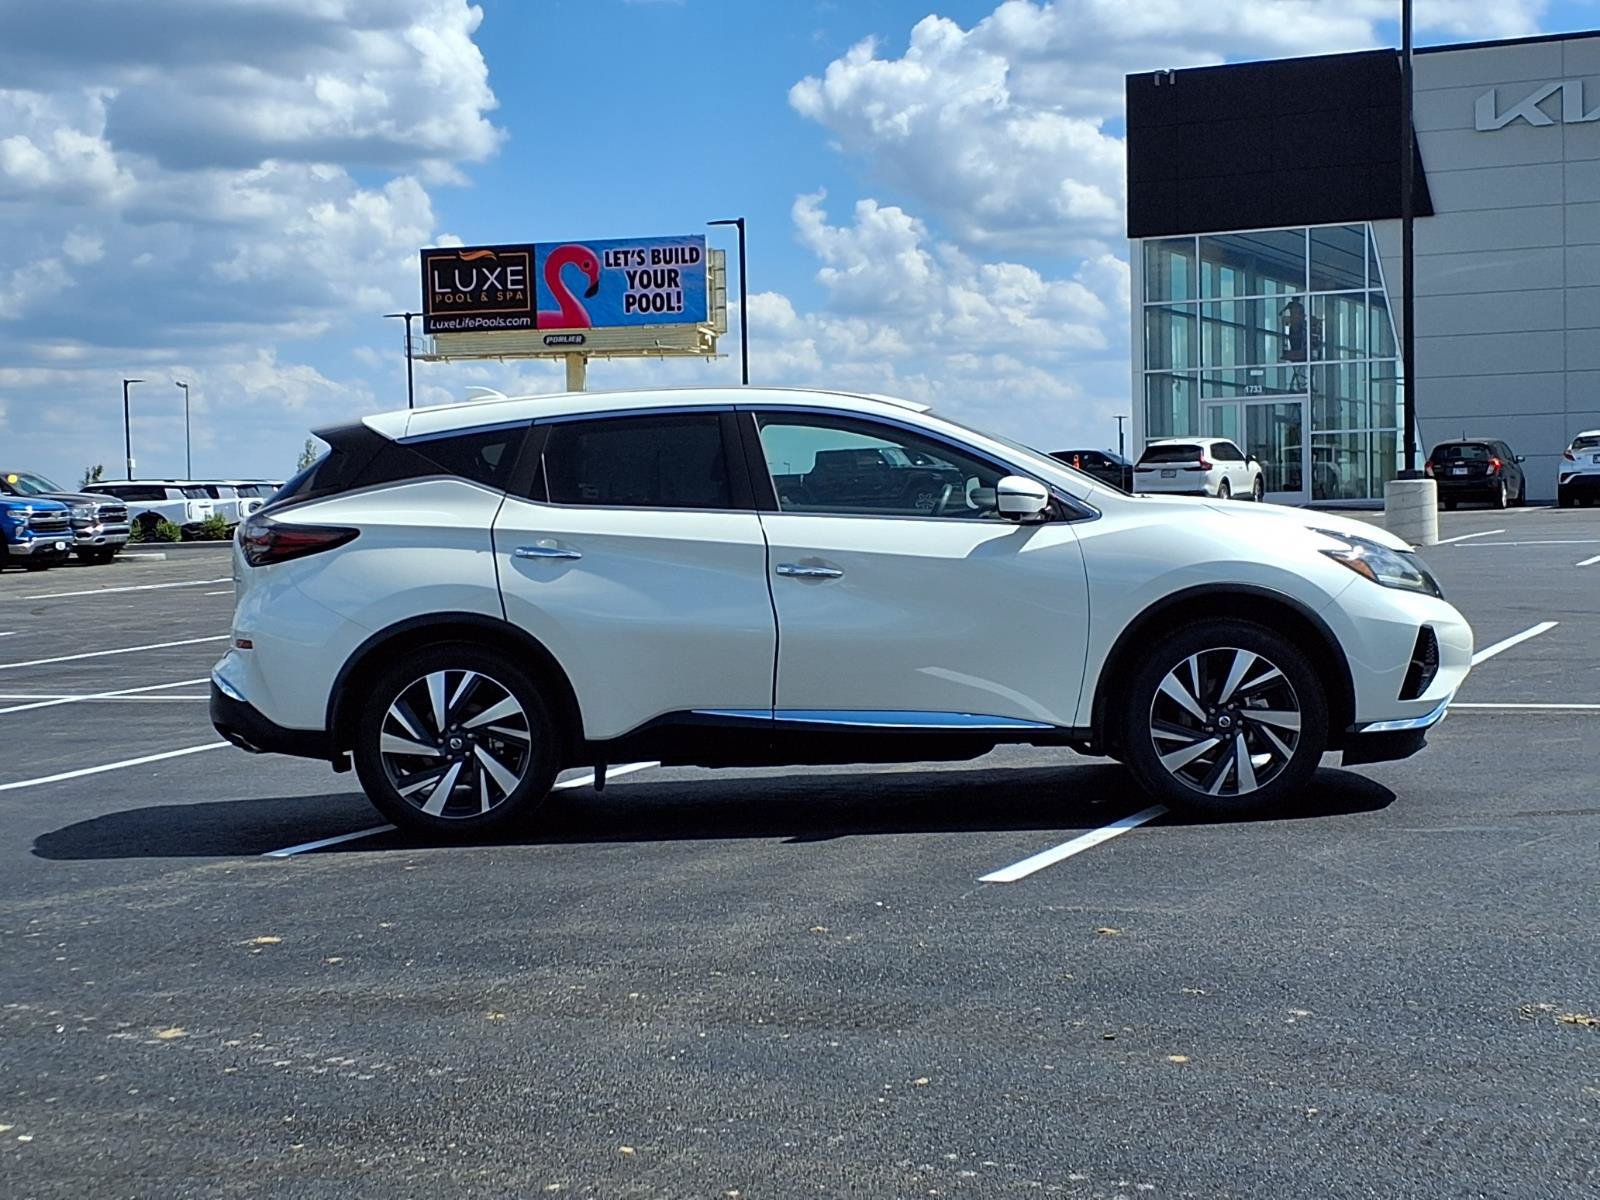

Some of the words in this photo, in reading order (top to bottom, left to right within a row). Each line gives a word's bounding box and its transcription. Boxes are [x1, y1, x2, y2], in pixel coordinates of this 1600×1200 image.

[1475, 80, 1600, 131] KI
[604, 249, 646, 267] LET'S
[650, 247, 700, 265] BUILD
[434, 266, 524, 292] LUXE
[625, 268, 680, 289] YOUR
[435, 293, 472, 303] POOL
[480, 292, 488, 301] &
[496, 291, 523, 301] SPA
[624, 290, 682, 313] POOL!
[430, 316, 531, 330] LuxeLifePools.com
[1244, 385, 1263, 393] 1733
